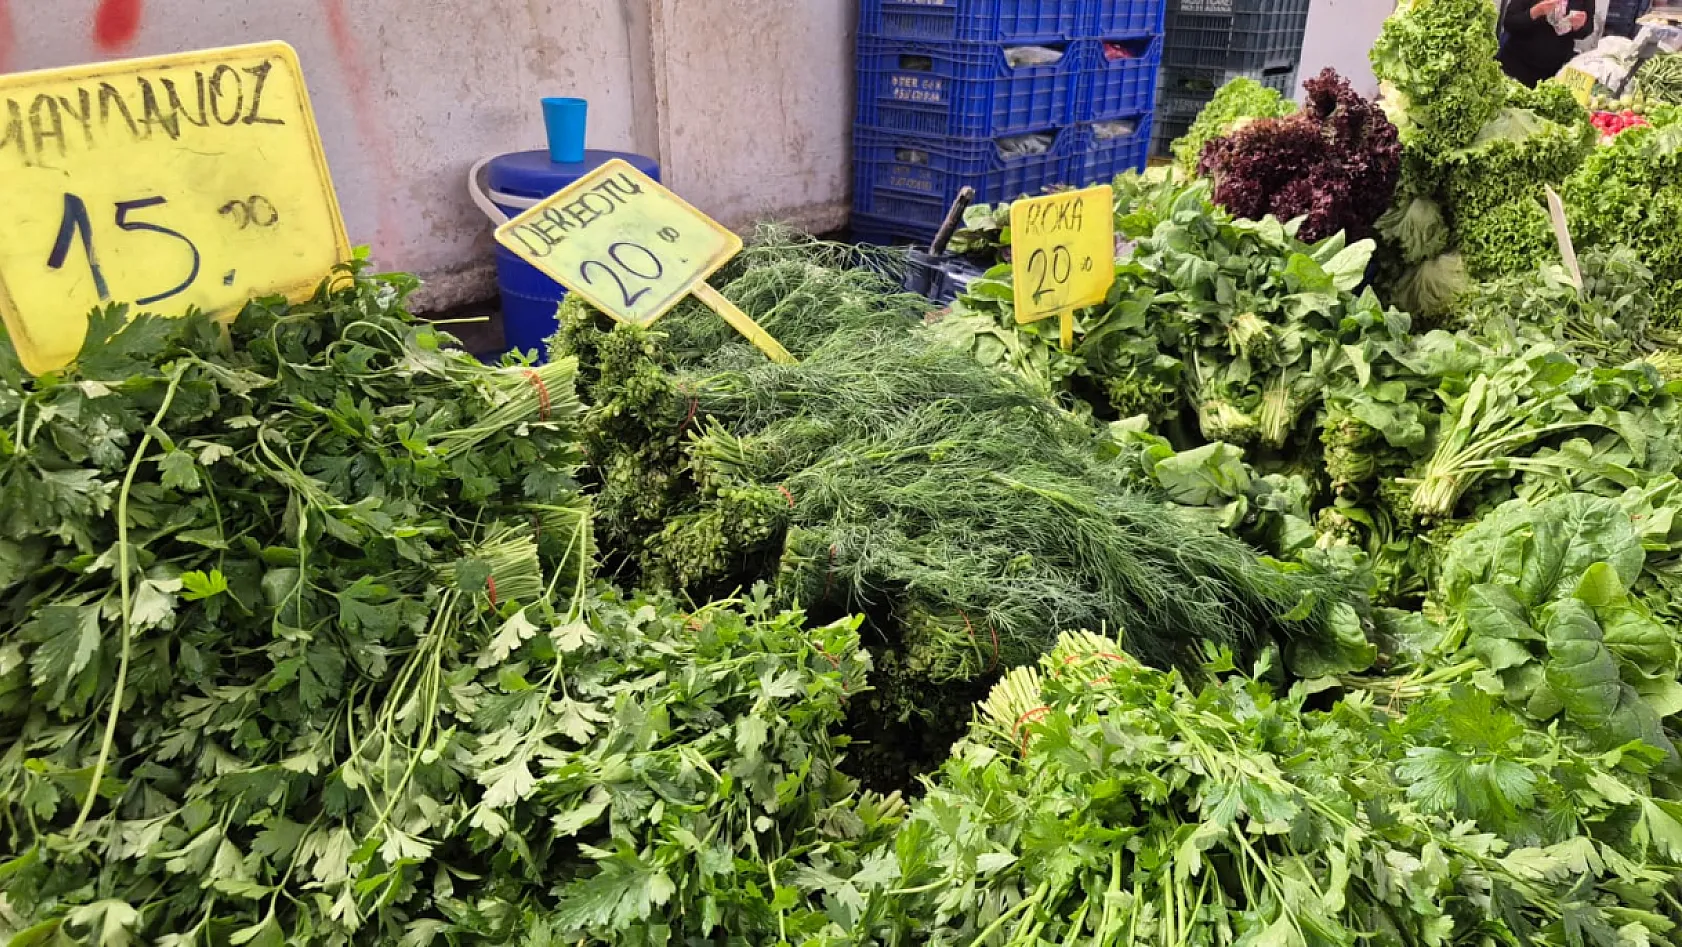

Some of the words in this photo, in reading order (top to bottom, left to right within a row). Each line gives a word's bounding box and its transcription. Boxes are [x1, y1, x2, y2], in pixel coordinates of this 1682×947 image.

[510, 172, 645, 258] DEREOTU
[1025, 197, 1084, 234] ROKA
[580, 242, 663, 307] 20
[1027, 245, 1072, 305] 20
